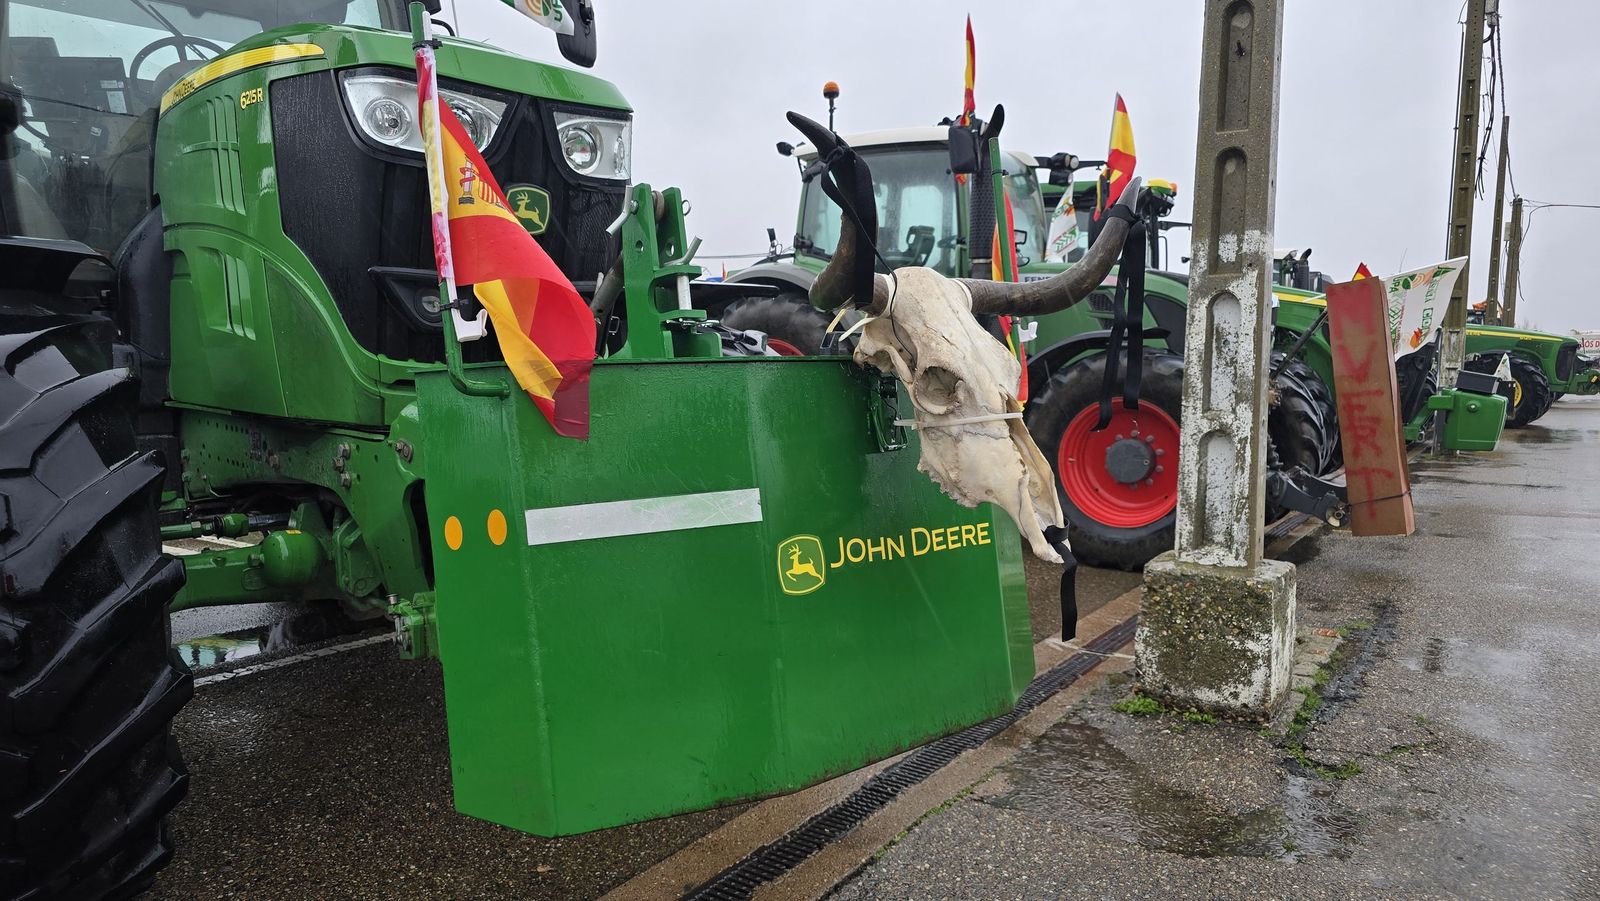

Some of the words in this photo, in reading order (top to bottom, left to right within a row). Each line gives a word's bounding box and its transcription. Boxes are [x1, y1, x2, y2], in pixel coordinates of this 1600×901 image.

[240, 88, 263, 109] 6215R
[830, 535, 906, 569] JOHN
[910, 522, 992, 556] DEERE
